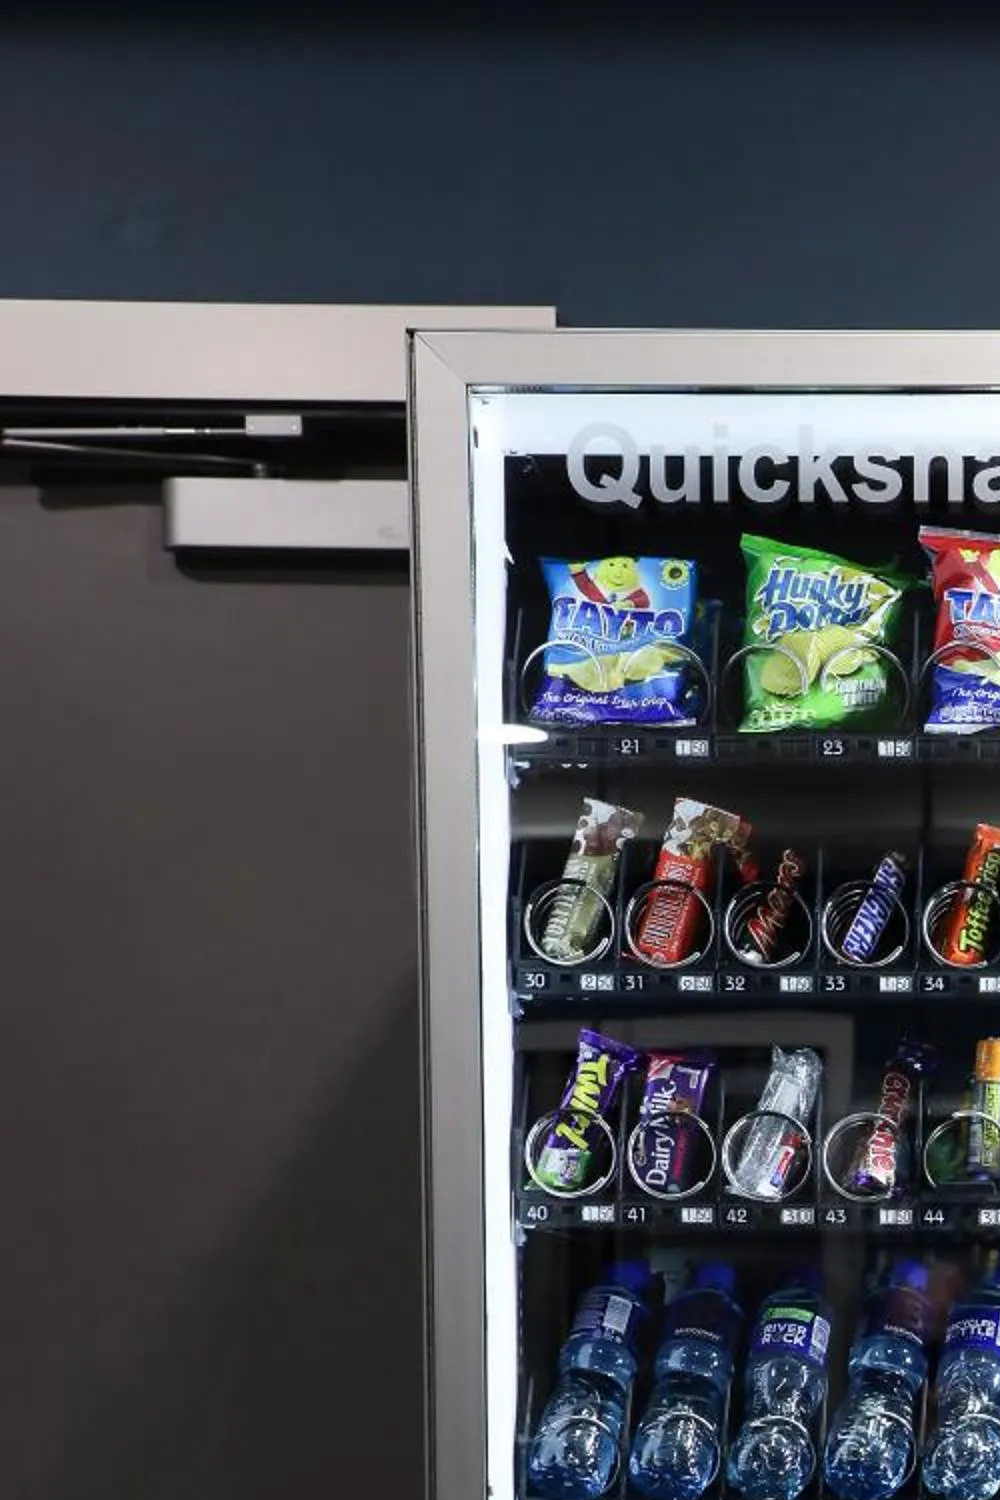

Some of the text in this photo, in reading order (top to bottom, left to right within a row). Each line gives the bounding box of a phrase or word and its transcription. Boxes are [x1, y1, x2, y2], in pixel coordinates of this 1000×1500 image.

[763, 567, 866, 612] Hunky
[552, 596, 685, 641] TAYTO
[621, 739, 638, 753] 21
[824, 740, 843, 755] 23
[959, 890, 993, 951] Toffee
[525, 973, 544, 988] 30
[626, 976, 642, 990] 31
[726, 976, 744, 990] 32
[826, 976, 844, 990] 33
[925, 977, 944, 990] 34
[645, 1080, 677, 1186] Dairy Milk
[527, 1206, 547, 1220] 40
[628, 1208, 644, 1221] 41
[727, 1209, 746, 1222] 42
[826, 1210, 846, 1223] 43
[924, 1210, 944, 1223] 44
